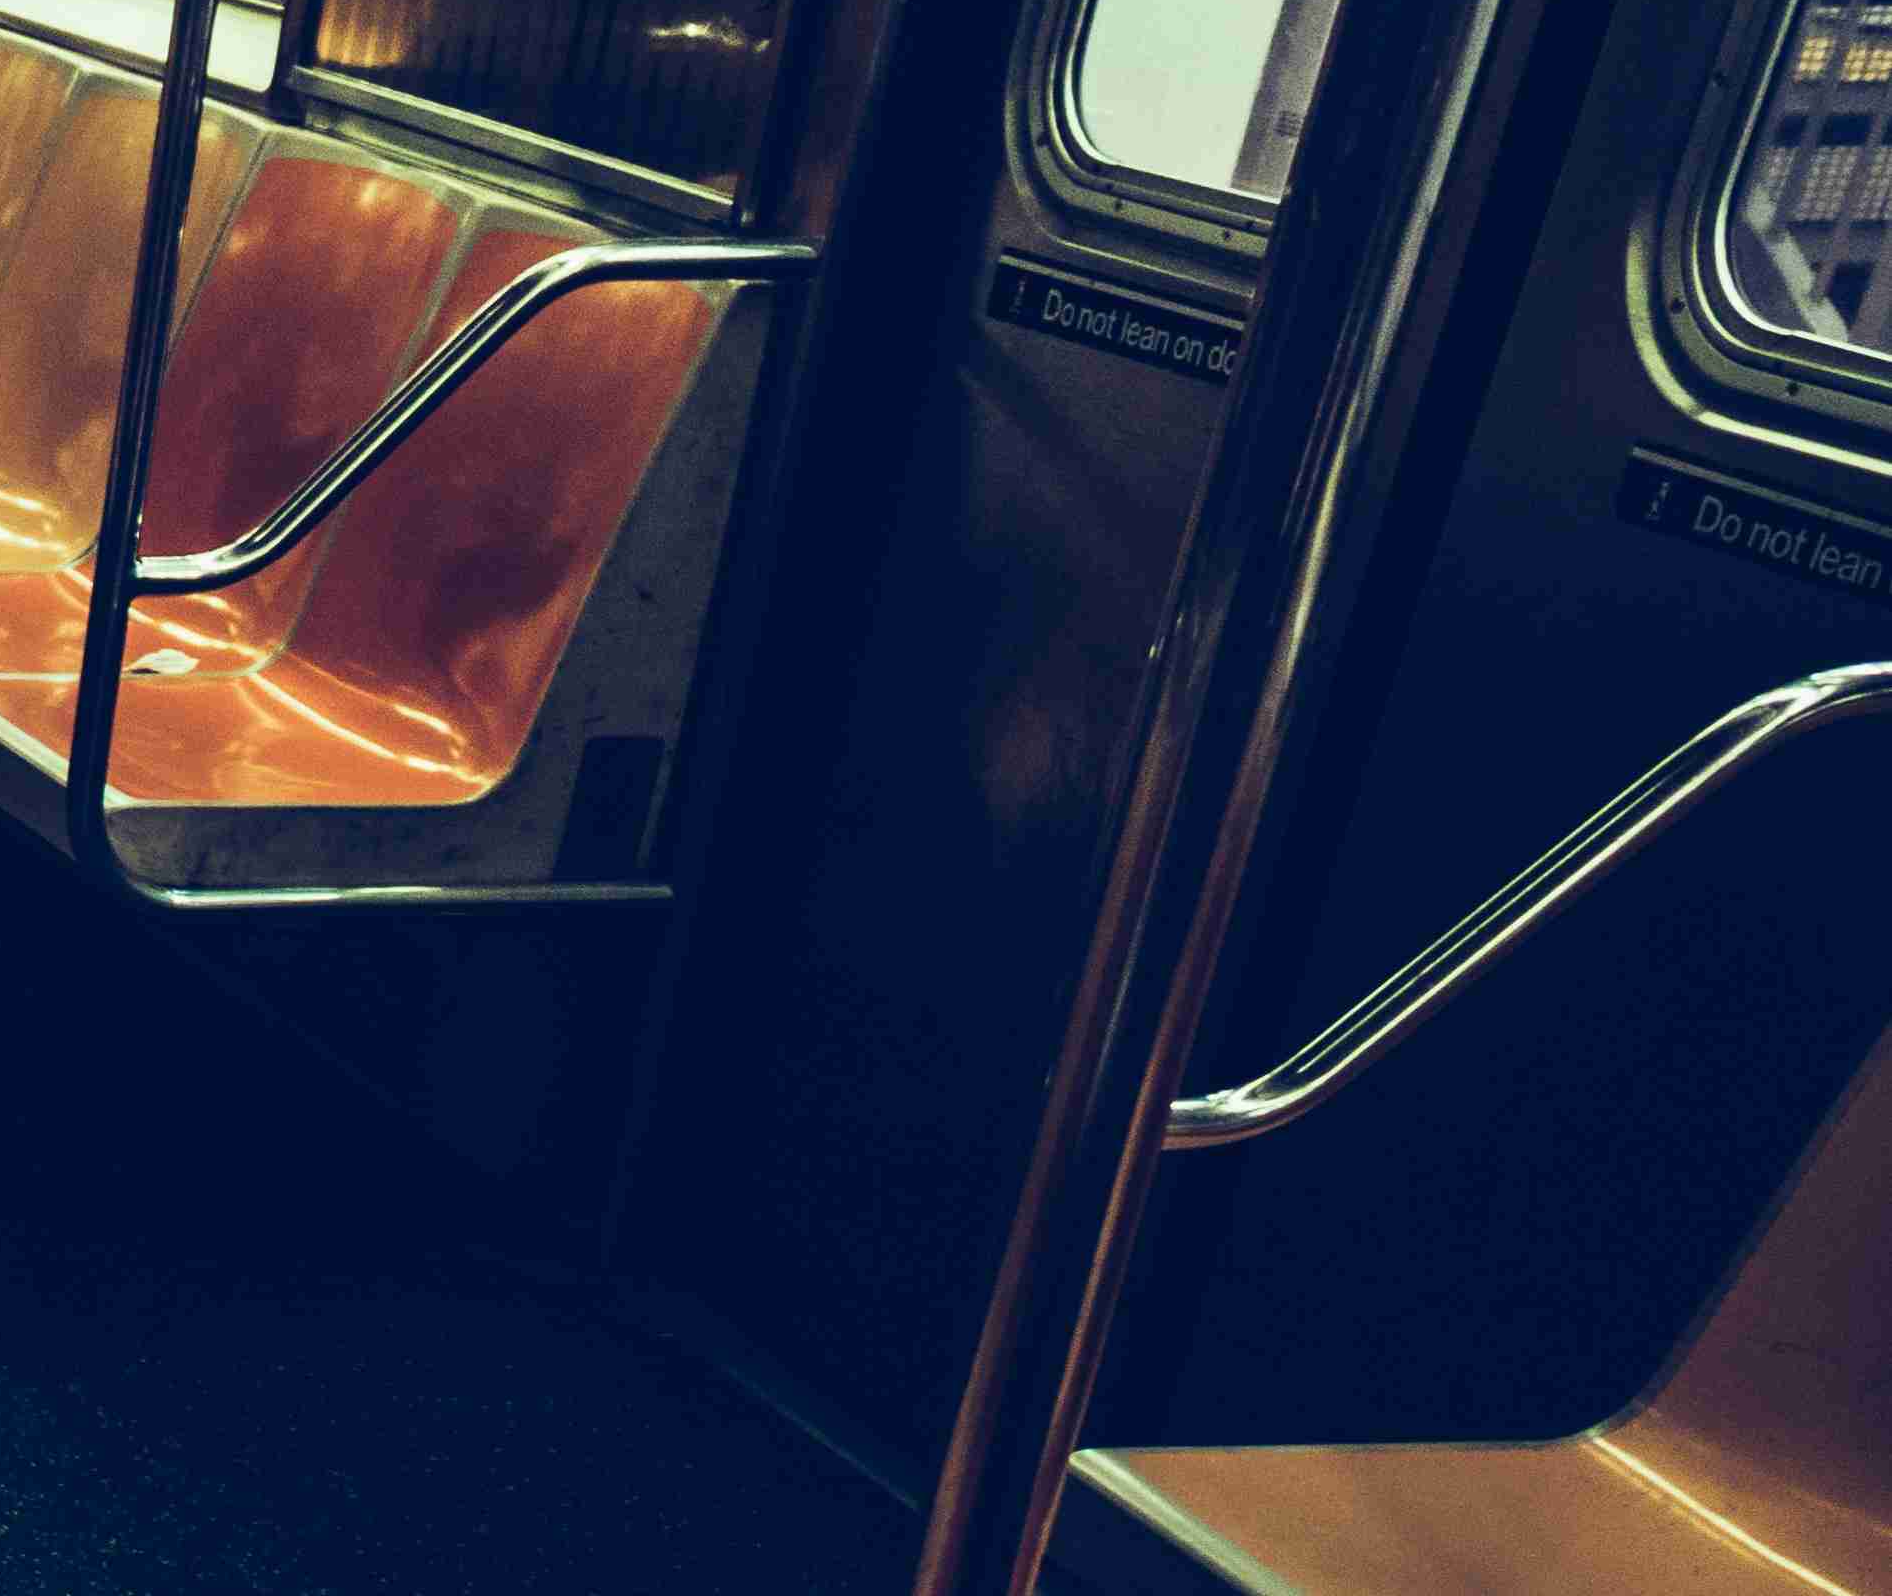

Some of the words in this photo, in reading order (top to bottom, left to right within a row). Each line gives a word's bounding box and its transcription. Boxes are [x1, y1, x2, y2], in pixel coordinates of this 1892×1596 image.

[1041, 287, 1075, 327] Do
[1076, 307, 1118, 340] not
[1120, 311, 1170, 356] lean
[1173, 335, 1204, 367] on
[1693, 493, 1743, 543] Do
[1746, 520, 1808, 565] not
[1809, 531, 1883, 589] lean
